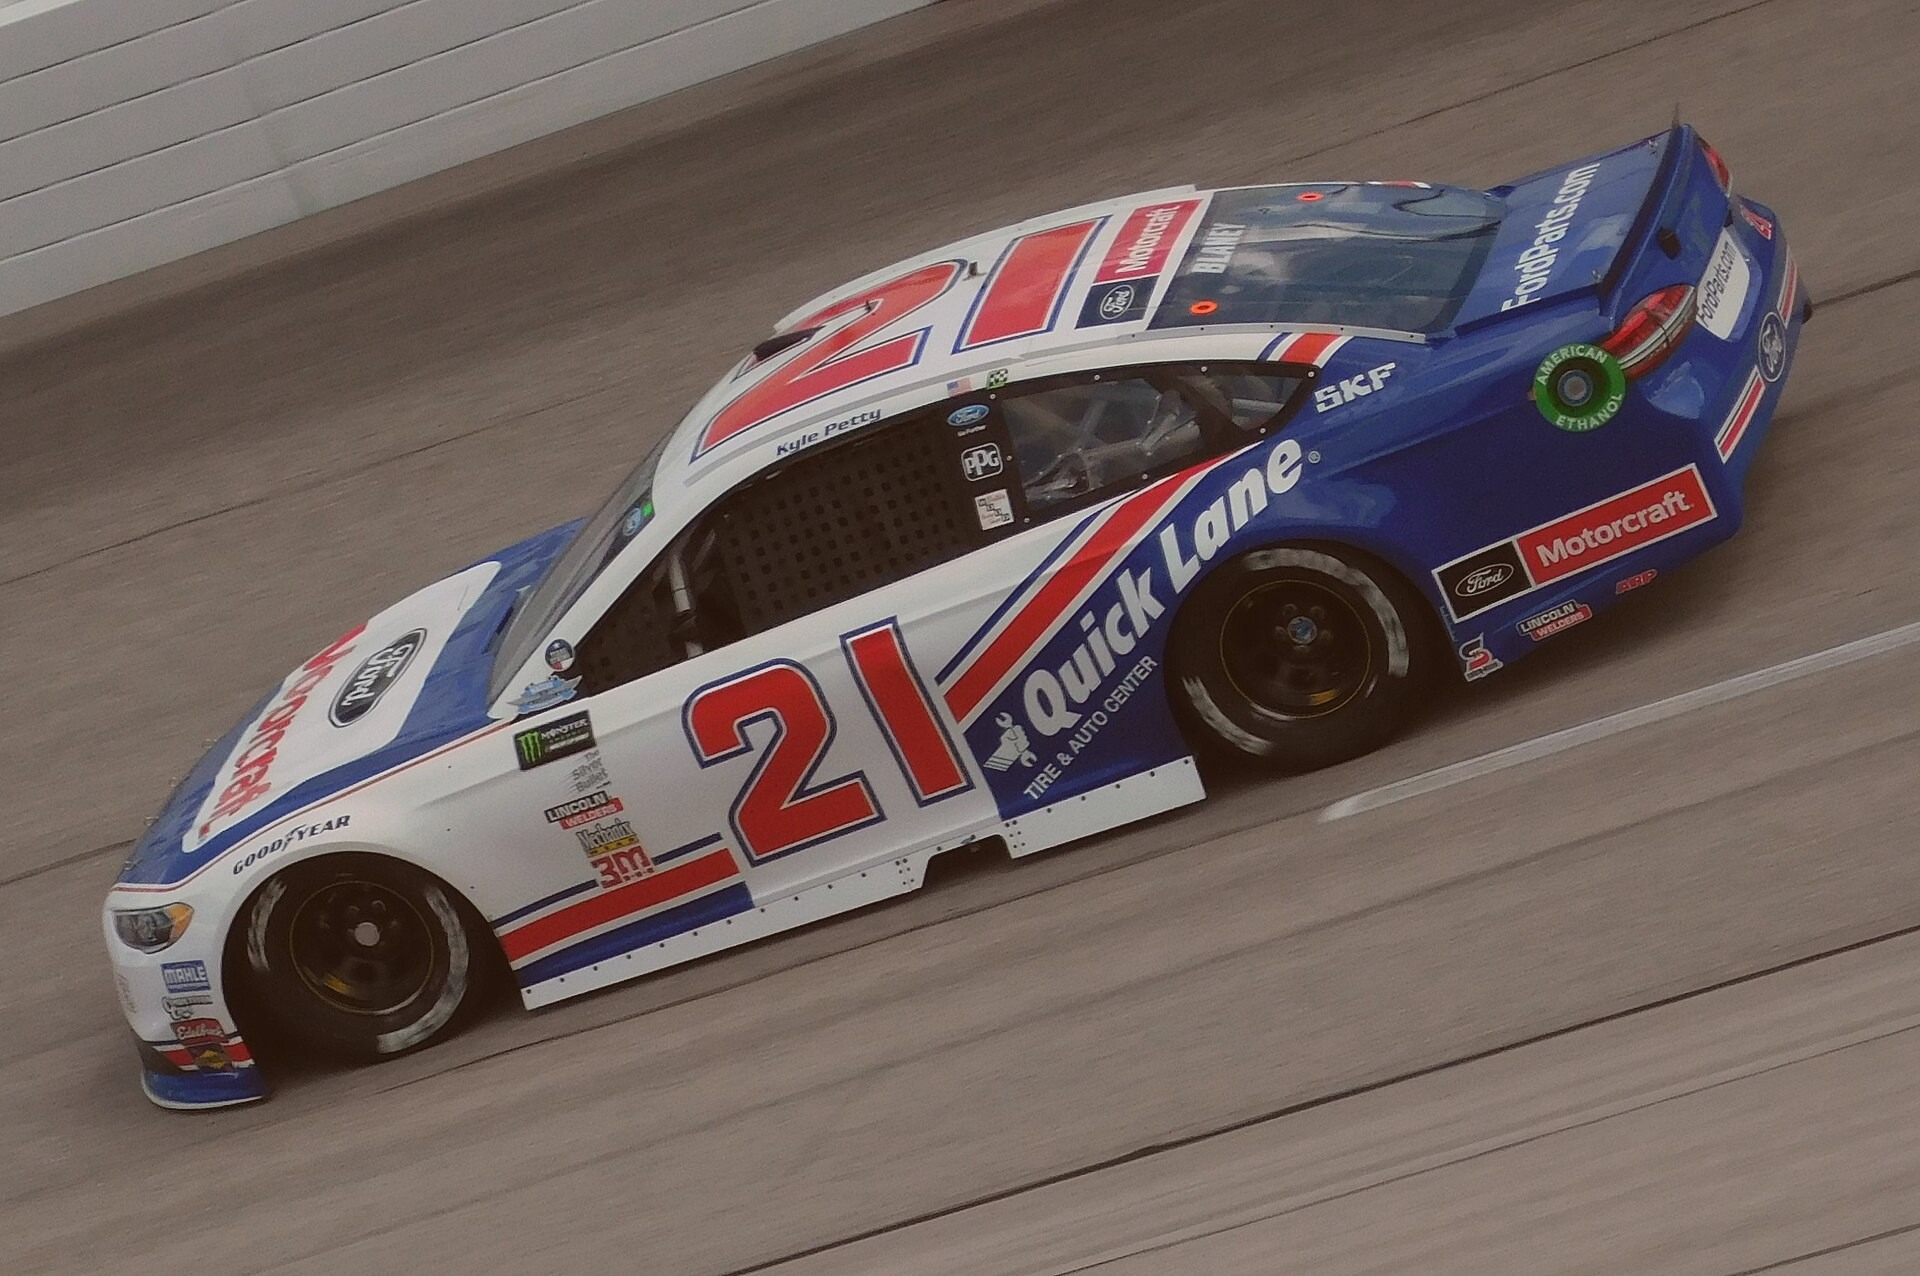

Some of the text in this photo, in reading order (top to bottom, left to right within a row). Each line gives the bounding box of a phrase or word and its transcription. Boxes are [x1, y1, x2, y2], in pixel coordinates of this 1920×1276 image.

[1115, 205, 1181, 275] Motorcraft
[1190, 222, 1246, 274] BLANEY
[1501, 162, 1601, 313] FordParts.com
[1699, 241, 1738, 329] FordParts.com
[688, 214, 1113, 465] 21
[1314, 362, 1396, 413] SKF
[1536, 345, 1608, 386] AMERICAN
[776, 408, 882, 456] Kyle Petty
[1555, 392, 1624, 432] ETHANOL
[963, 449, 1001, 476] PPG
[1535, 489, 1692, 569] Motorcraft
[1023, 438, 1303, 737] Quick Lane
[1466, 568, 1504, 594] Ford
[1520, 602, 1577, 635] LINCOLN
[1534, 609, 1586, 639] WELDERS
[681, 615, 976, 868] 21
[1022, 654, 1160, 800] TIRE & AUTO CENTER
[546, 791, 609, 822] LINCOLN
[565, 803, 618, 828] WELDERS
[233, 814, 351, 876] GOODYEAR
[590, 845, 652, 889] 3M
[163, 966, 207, 985] MAHLE
